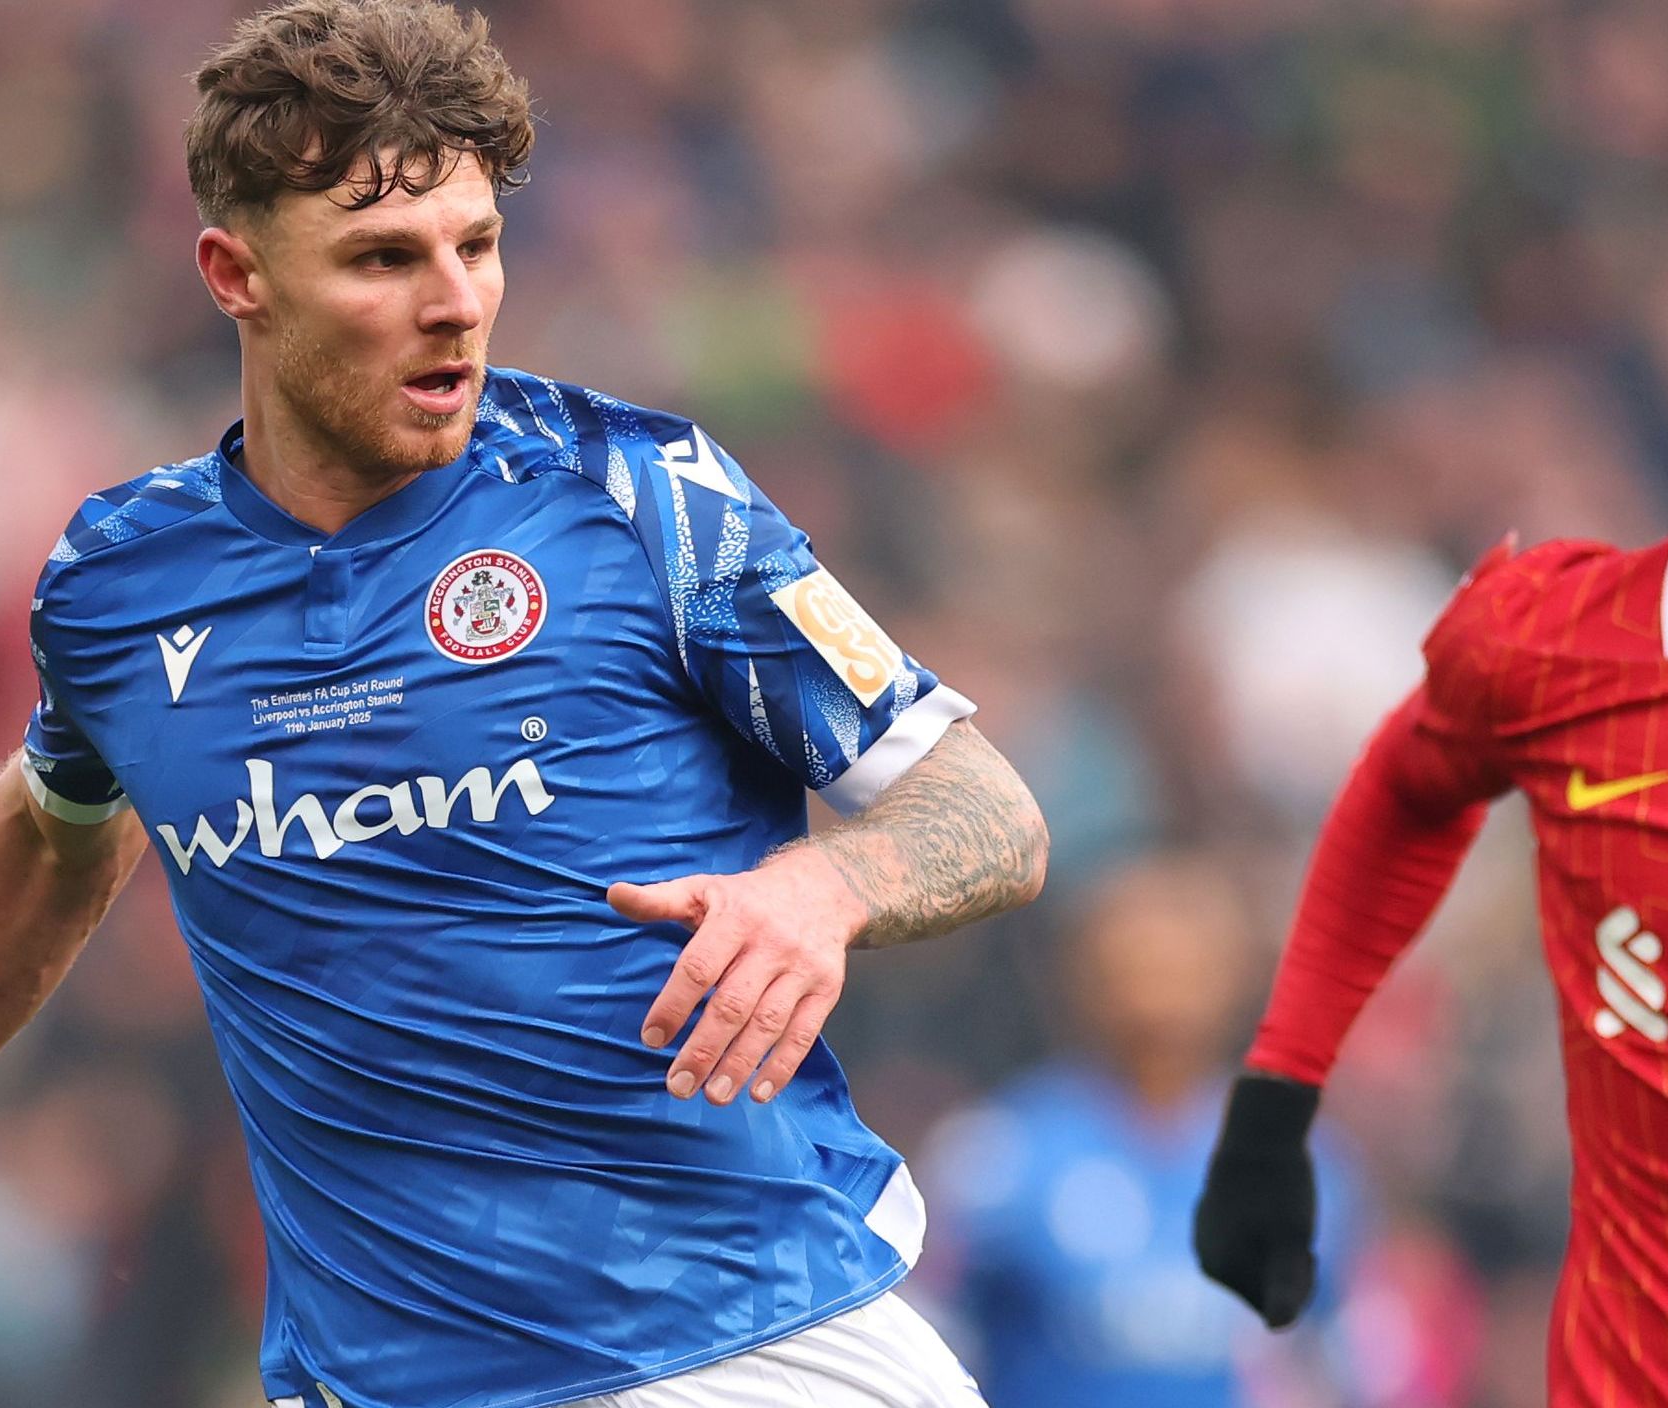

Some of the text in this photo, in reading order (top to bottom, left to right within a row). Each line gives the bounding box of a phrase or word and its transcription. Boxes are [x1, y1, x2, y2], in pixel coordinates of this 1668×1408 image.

[431, 556, 539, 614] ACCRINGTON STANLEY
[440, 618, 532, 656] FOOTBALL CLUB
[251, 676, 404, 711] The Emirates FA Cup 3rd Round
[253, 691, 404, 725] Liverpool vs Accrington Stanley
[285, 711, 372, 734] 11th January 2025
[156, 758, 555, 876] wham
